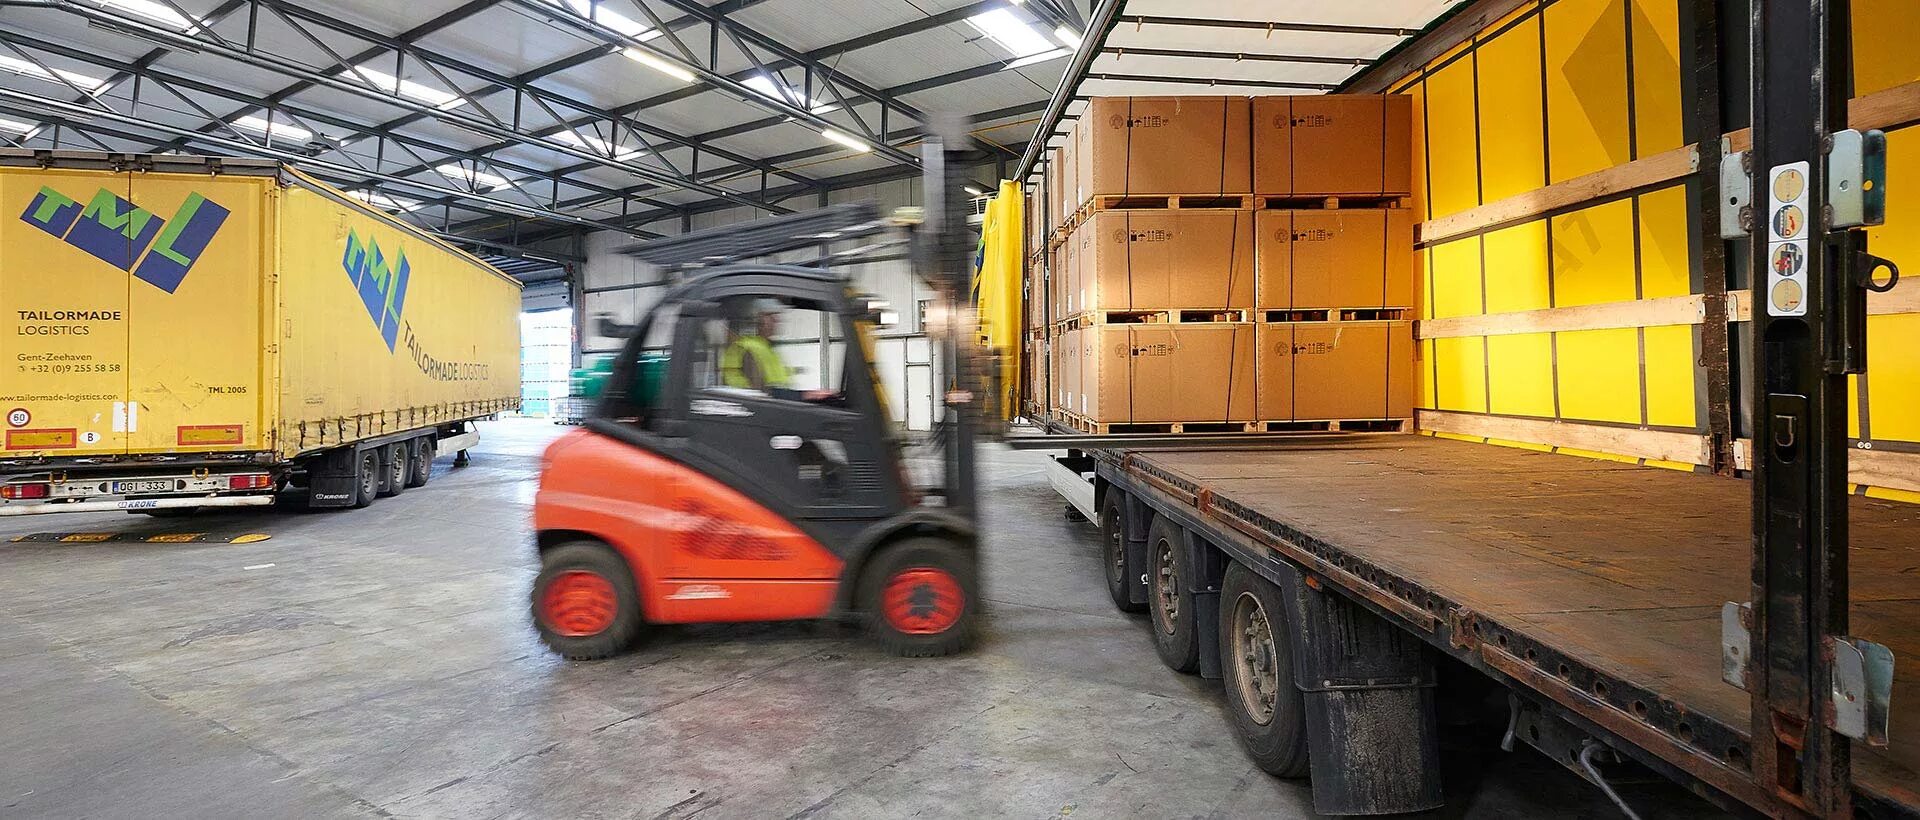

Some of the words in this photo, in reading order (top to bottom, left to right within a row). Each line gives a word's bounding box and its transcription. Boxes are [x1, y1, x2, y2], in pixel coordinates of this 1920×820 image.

[33, 185, 206, 267] TML
[346, 225, 405, 326] TML
[17, 310, 121, 321] TAILORMADE
[17, 325, 90, 336] LOGISTICS
[403, 319, 458, 381] TAILORMADE
[458, 362, 489, 381] LOGISTICS
[17, 352, 92, 361] Gent-Zeehaven
[31, 364, 49, 373] +32
[52, 364, 71, 374] (0)9
[74, 364, 92, 373] 255
[94, 364, 106, 373] 58
[109, 364, 121, 372] 58
[208, 386, 225, 394] TML
[227, 386, 247, 394] 2005
[13, 413, 26, 422] 60
[87, 433, 94, 442] B
[127, 500, 158, 508] KRONE
